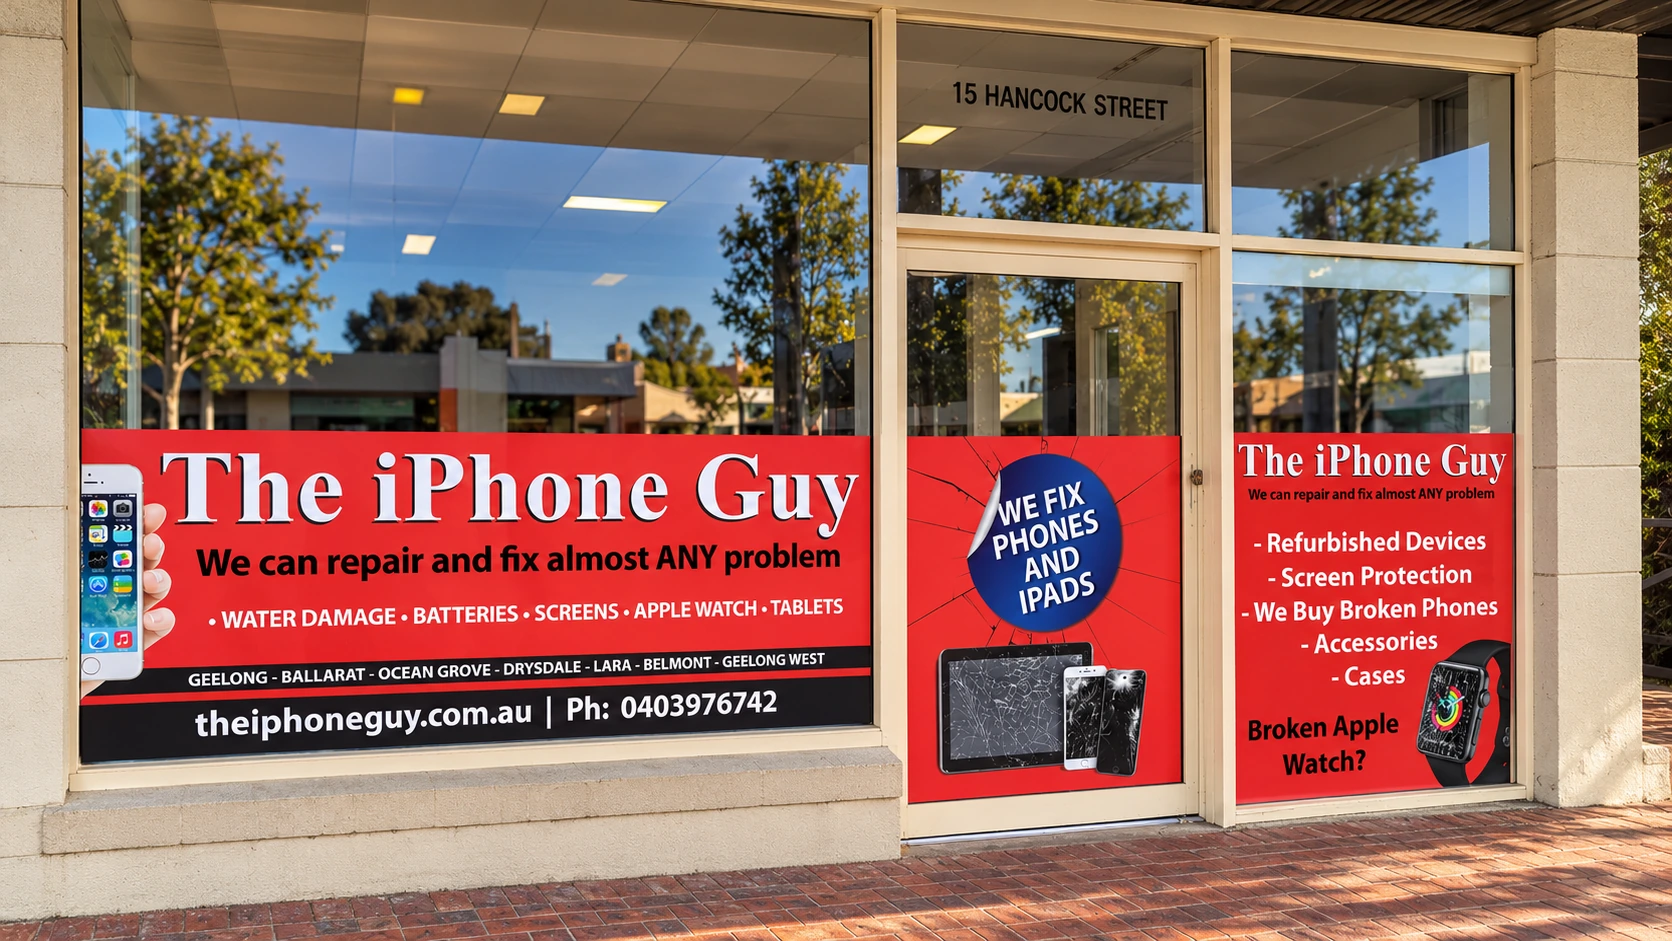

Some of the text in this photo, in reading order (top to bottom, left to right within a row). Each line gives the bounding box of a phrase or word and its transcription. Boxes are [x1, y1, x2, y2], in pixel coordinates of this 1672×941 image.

[953, 82, 1168, 121] 15 HANCOCK STREET
[1239, 444, 1506, 484] The iPhone Guy
[159, 452, 859, 539] The iPhone Guy
[999, 482, 1085, 526] WE FIX
[1249, 487, 1494, 502] We can repair and fix almost ANY problem
[992, 509, 1098, 560] PHONES
[1268, 531, 1399, 552] Refurbished
[1407, 531, 1486, 551] Devices
[196, 543, 840, 581] We can repair and fix almost ANY problem
[1024, 546, 1080, 582] AND
[1282, 568, 1354, 587] Screen
[1362, 564, 1471, 585] Protection
[1019, 571, 1095, 614] IPADS
[221, 610, 296, 628] WATER
[302, 608, 396, 627] DAMAGE
[414, 605, 518, 624] BATTERIES
[535, 603, 618, 621] SCREENS
[634, 602, 691, 618] APPLE
[695, 600, 757, 617] WATCH
[770, 598, 843, 615] TABLETS
[1254, 602, 1287, 622] We
[1294, 601, 1334, 626] Buy
[1341, 598, 1415, 619] Broken
[1423, 597, 1498, 617] Phones
[1314, 631, 1437, 653] Accessories
[189, 671, 267, 686] GEELONG
[282, 668, 365, 683] BALLARAT
[379, 666, 433, 679] OCEAN
[438, 664, 491, 677] GROVE
[504, 661, 581, 675] DRYSDALE
[594, 659, 631, 672] LARA
[644, 657, 711, 670] BELMONT
[723, 654, 785, 667] GEELONG
[789, 653, 825, 665] WEST
[1345, 666, 1405, 686] Cases
[195, 705, 532, 741] theiphoneguy.com.au
[568, 696, 608, 721] Ph:
[621, 690, 777, 718] 0403976742
[1249, 713, 1398, 741] Broken Apple
[1283, 750, 1365, 775] Watch?
